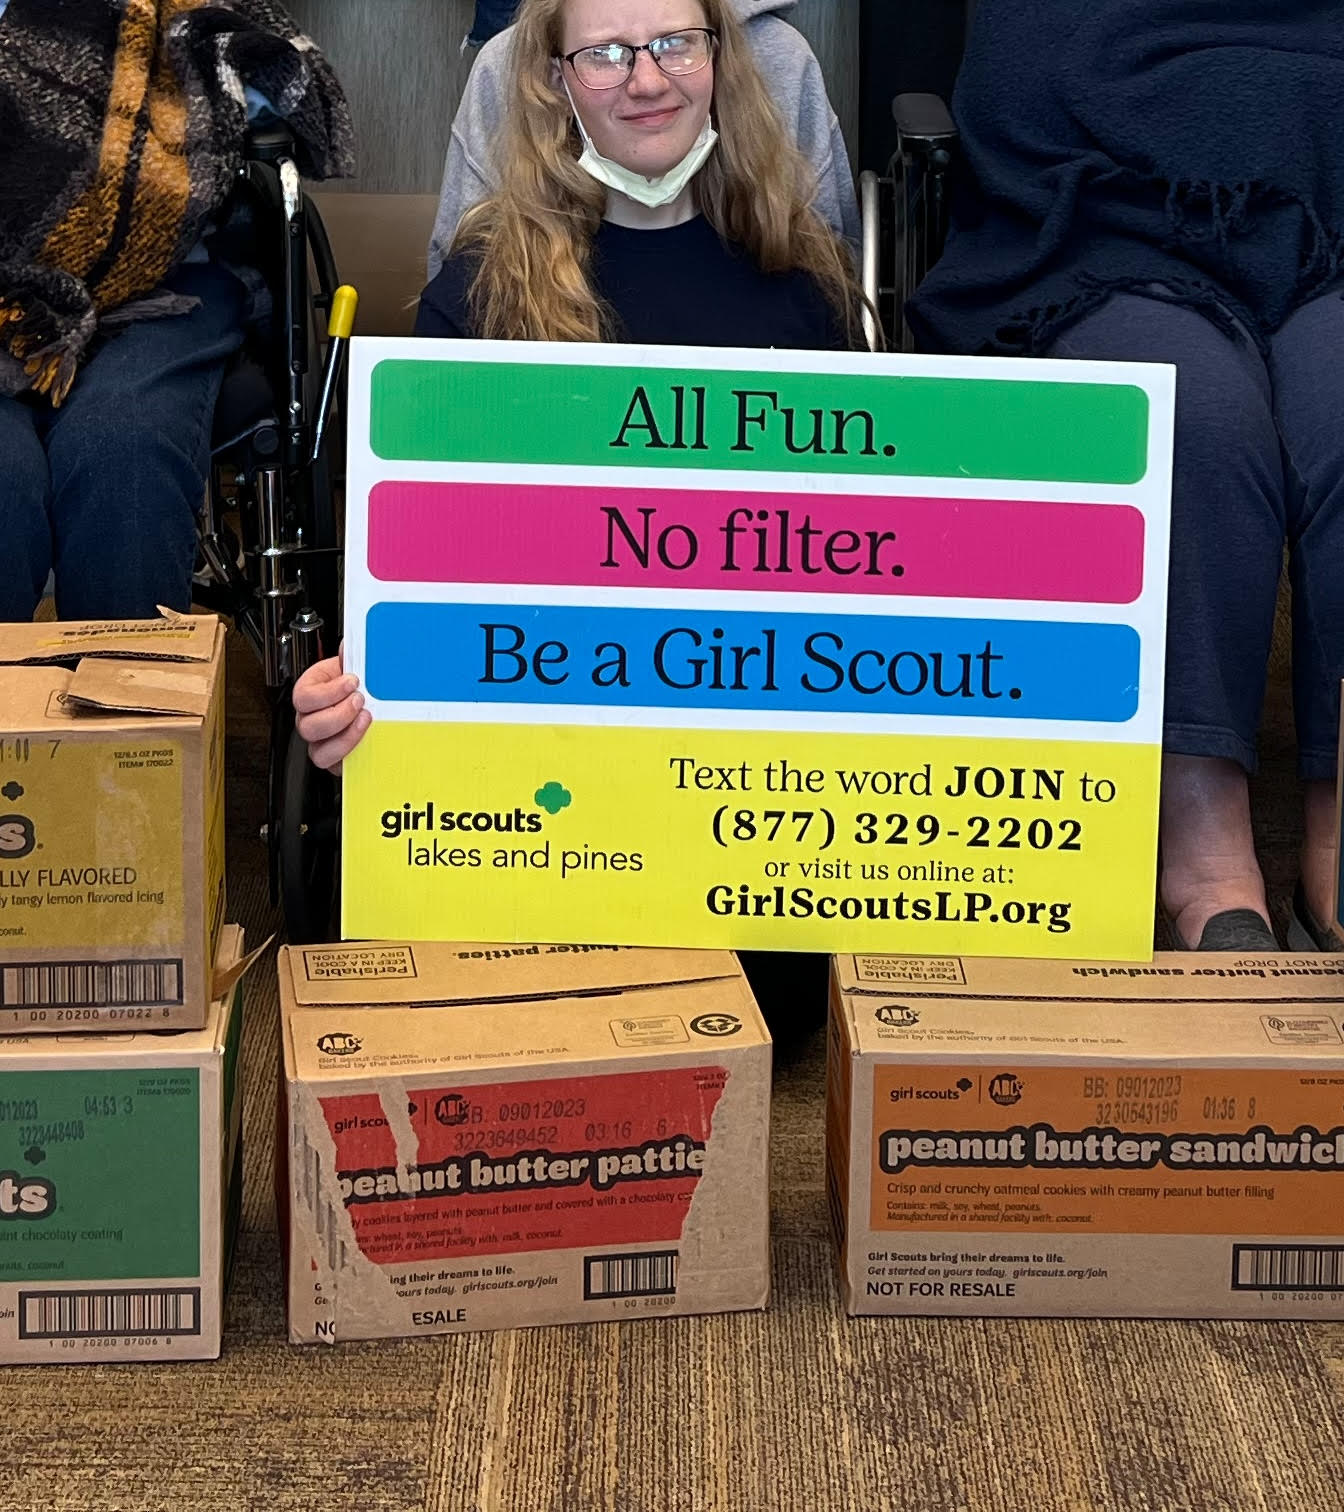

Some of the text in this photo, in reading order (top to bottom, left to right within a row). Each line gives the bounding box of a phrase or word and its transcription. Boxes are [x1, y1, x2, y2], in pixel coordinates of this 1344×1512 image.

[610, 385, 897, 457] All Fun.
[600, 506, 905, 577] No filter.
[478, 624, 1023, 699] Be a Girl Scout.
[48, 740, 62, 759] 7
[669, 759, 1117, 803] Text the word JOIN to
[382, 802, 541, 837] girl scouts
[711, 805, 1082, 852] (877) 329-2202
[407, 838, 643, 878] lakes and pines
[38, 867, 137, 887] FLAVORED
[764, 858, 1013, 884] or visit us online at:
[12, 893, 42, 908] tangy
[47, 892, 83, 904] lemon
[88, 890, 133, 904] flavored
[706, 886, 1072, 933] GirlScoutsLP.org
[312, 952, 375, 962] LOCATION
[376, 958, 407, 966] KEEP
[314, 966, 408, 978] Perishable
[1191, 968, 1266, 978] butter
[30, 1012, 46, 1021] 00
[57, 1010, 99, 1020] 20200
[322, 1037, 356, 1049] ABC
[890, 1086, 960, 1101] girl scouts
[993, 1080, 1019, 1096] ABC
[886, 1132, 1026, 1167] peanut
[1034, 1130, 1162, 1163] butter
[469, 1156, 590, 1188] butter
[887, 1182, 1274, 1199] Crisp and crunchy oatmeal cookies with creamy peanut butter filling
[409, 1273, 434, 1283] their
[438, 1270, 479, 1280] dreams
[482, 1269, 493, 1277] to
[866, 1282, 1015, 1297] NOT FOR RESALE
